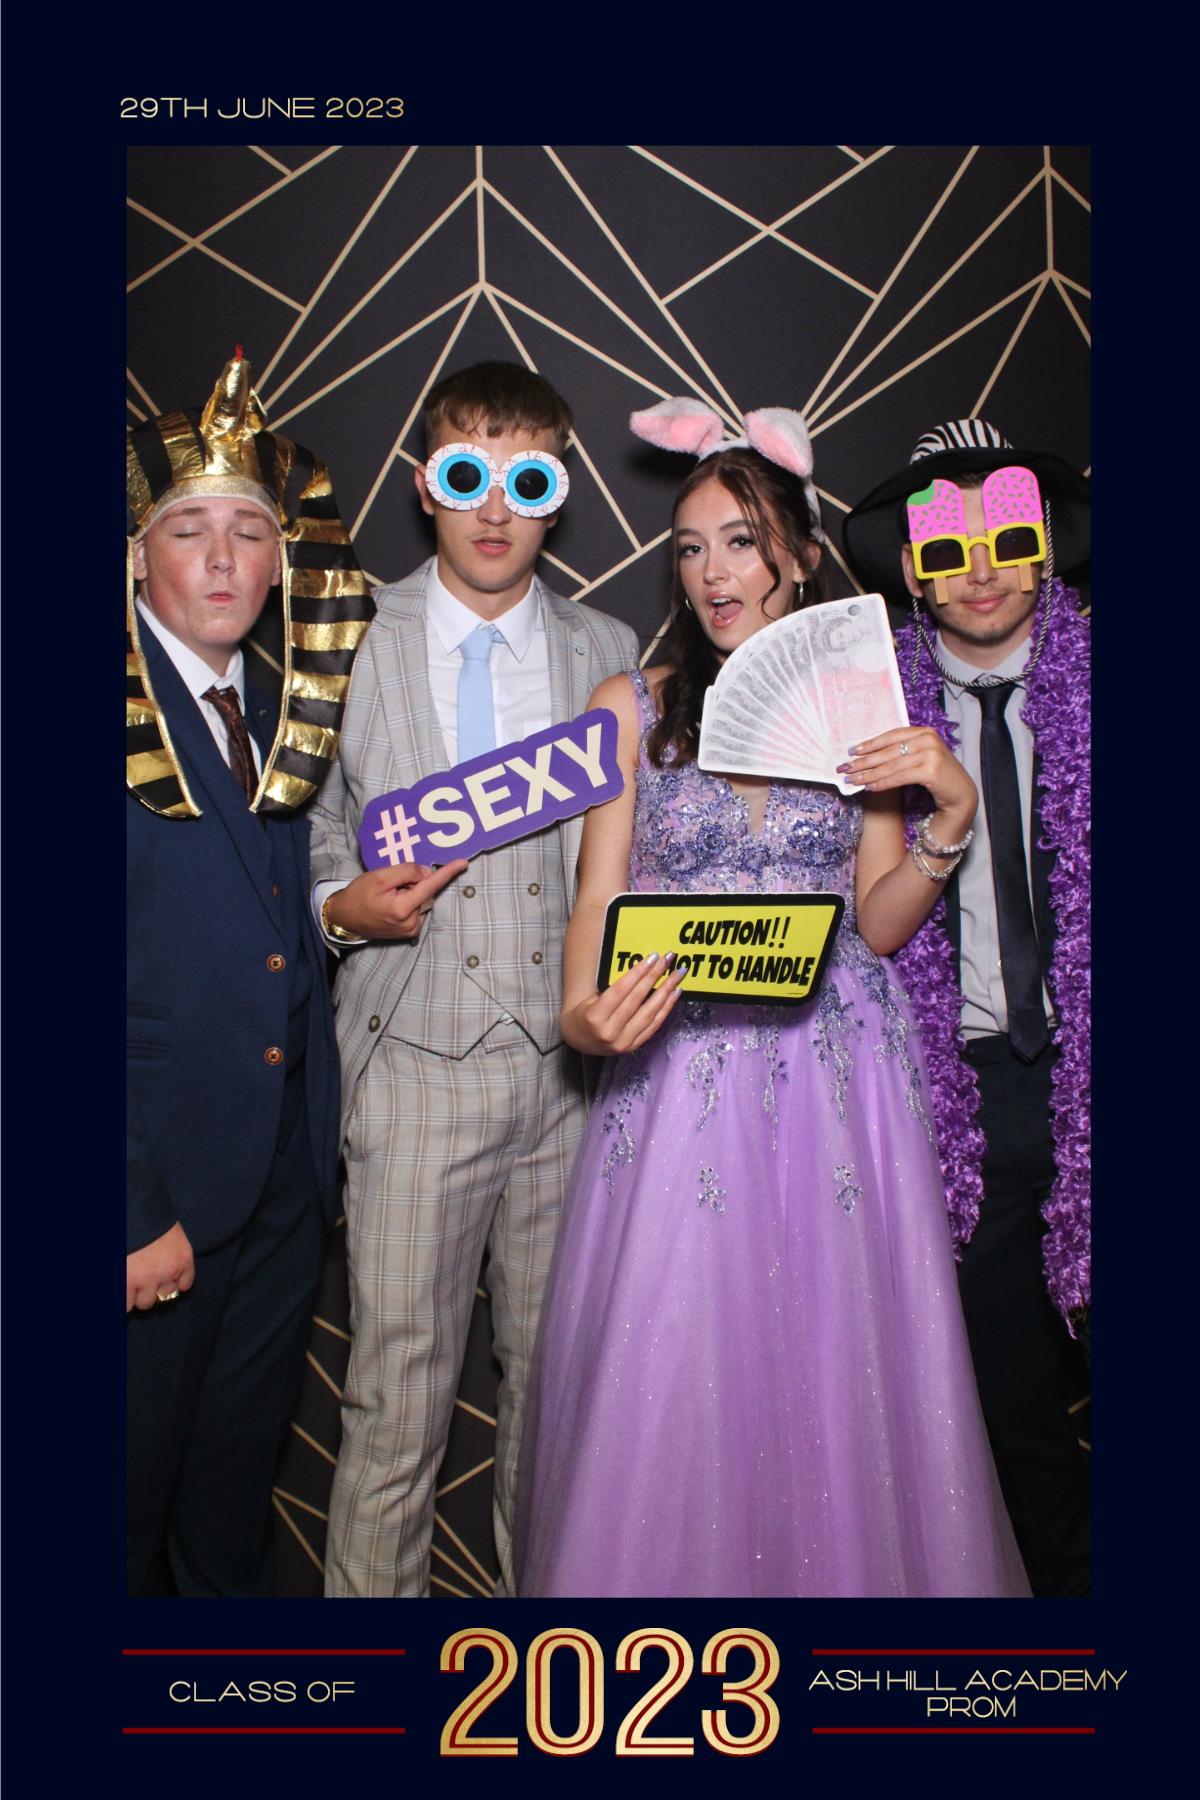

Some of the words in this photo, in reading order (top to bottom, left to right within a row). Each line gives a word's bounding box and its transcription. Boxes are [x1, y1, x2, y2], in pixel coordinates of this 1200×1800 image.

[374, 723, 609, 867] #SEXY
[679, 917, 791, 949] CAUTION!!
[617, 951, 652, 973] TO
[708, 955, 734, 980] TO
[735, 955, 816, 986] HANDLE
